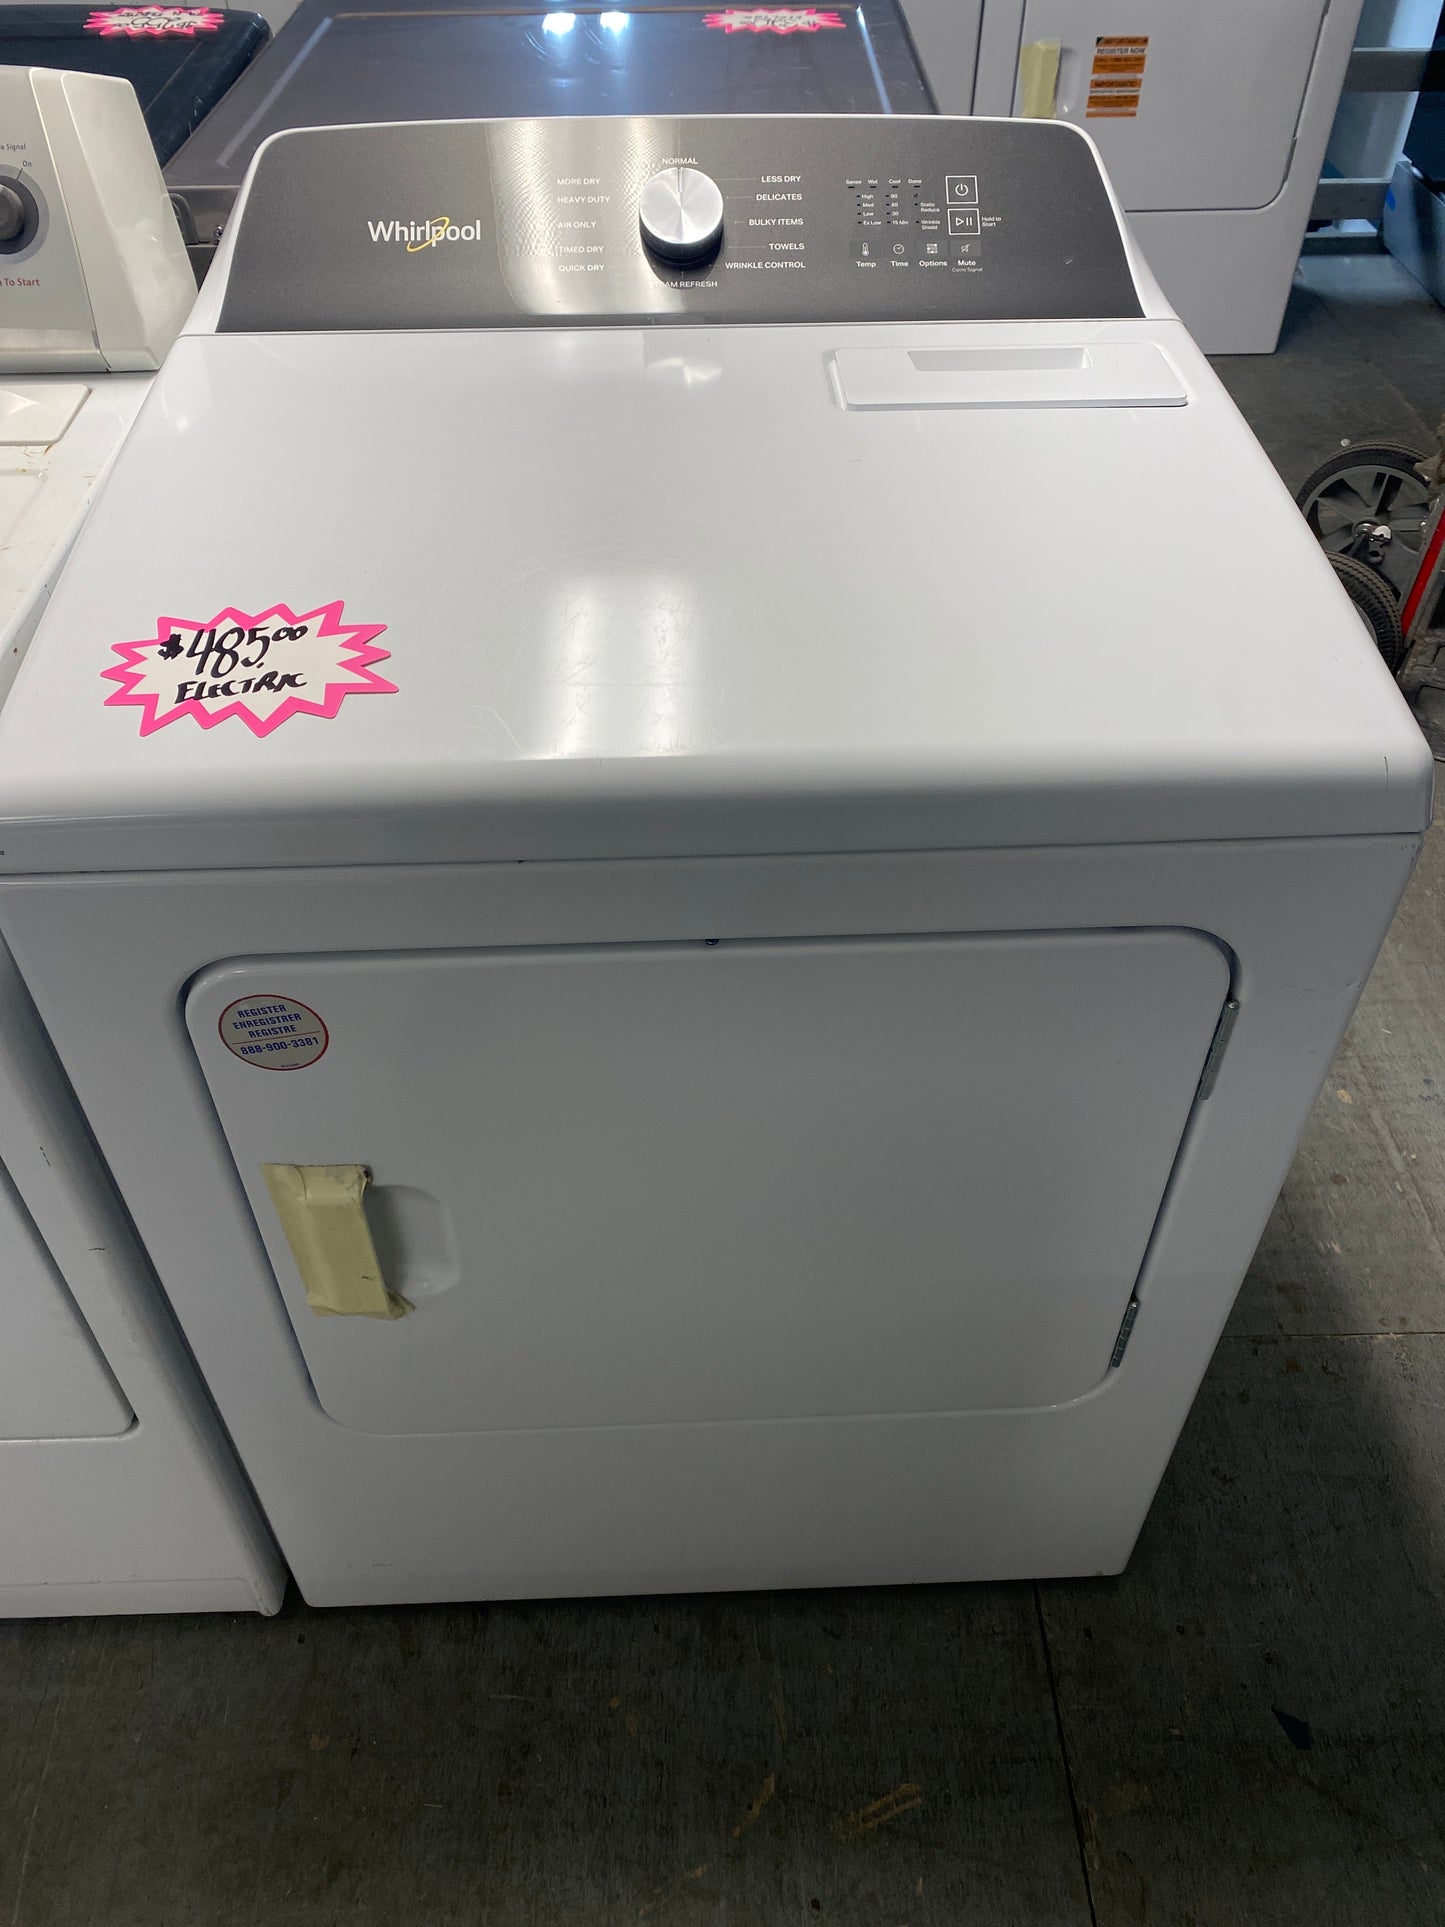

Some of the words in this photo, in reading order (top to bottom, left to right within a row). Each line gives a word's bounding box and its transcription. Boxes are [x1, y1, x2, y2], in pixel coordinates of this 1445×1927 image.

[6, 142, 26, 151] Signal
[661, 157, 698, 165] NORMAL
[583, 177, 600, 185] DRY
[761, 175, 782, 183] LESS
[784, 175, 801, 183] DRY
[557, 196, 586, 204] HEAVY
[756, 193, 803, 201] DELICATES
[557, 221, 572, 229] AIR
[573, 220, 597, 229] ONLY
[748, 218, 776, 226] BULKY
[777, 217, 804, 225] ITEMS
[367, 218, 481, 249] Whirlpool
[559, 245, 585, 253] TIMED
[586, 245, 604, 253] DRY
[769, 242, 805, 250] TOWELS
[558, 264, 586, 272] QUICK
[725, 261, 764, 269] WRINKLE
[764, 261, 806, 269] CONTROL
[855, 260, 877, 268] Temp
[918, 260, 948, 268] Options
[957, 259, 977, 267] Mute
[4, 277, 15, 287] To
[17, 277, 40, 287] Start
[680, 280, 718, 288] REFRESH
[174, 670, 307, 704] ELECTRIC
[237, 1004, 287, 1018] REGISTER
[233, 1013, 302, 1030] ENREGISTRER
[248, 1024, 297, 1038] REGISTRE
[240, 1037, 319, 1055] 888-900-3381
